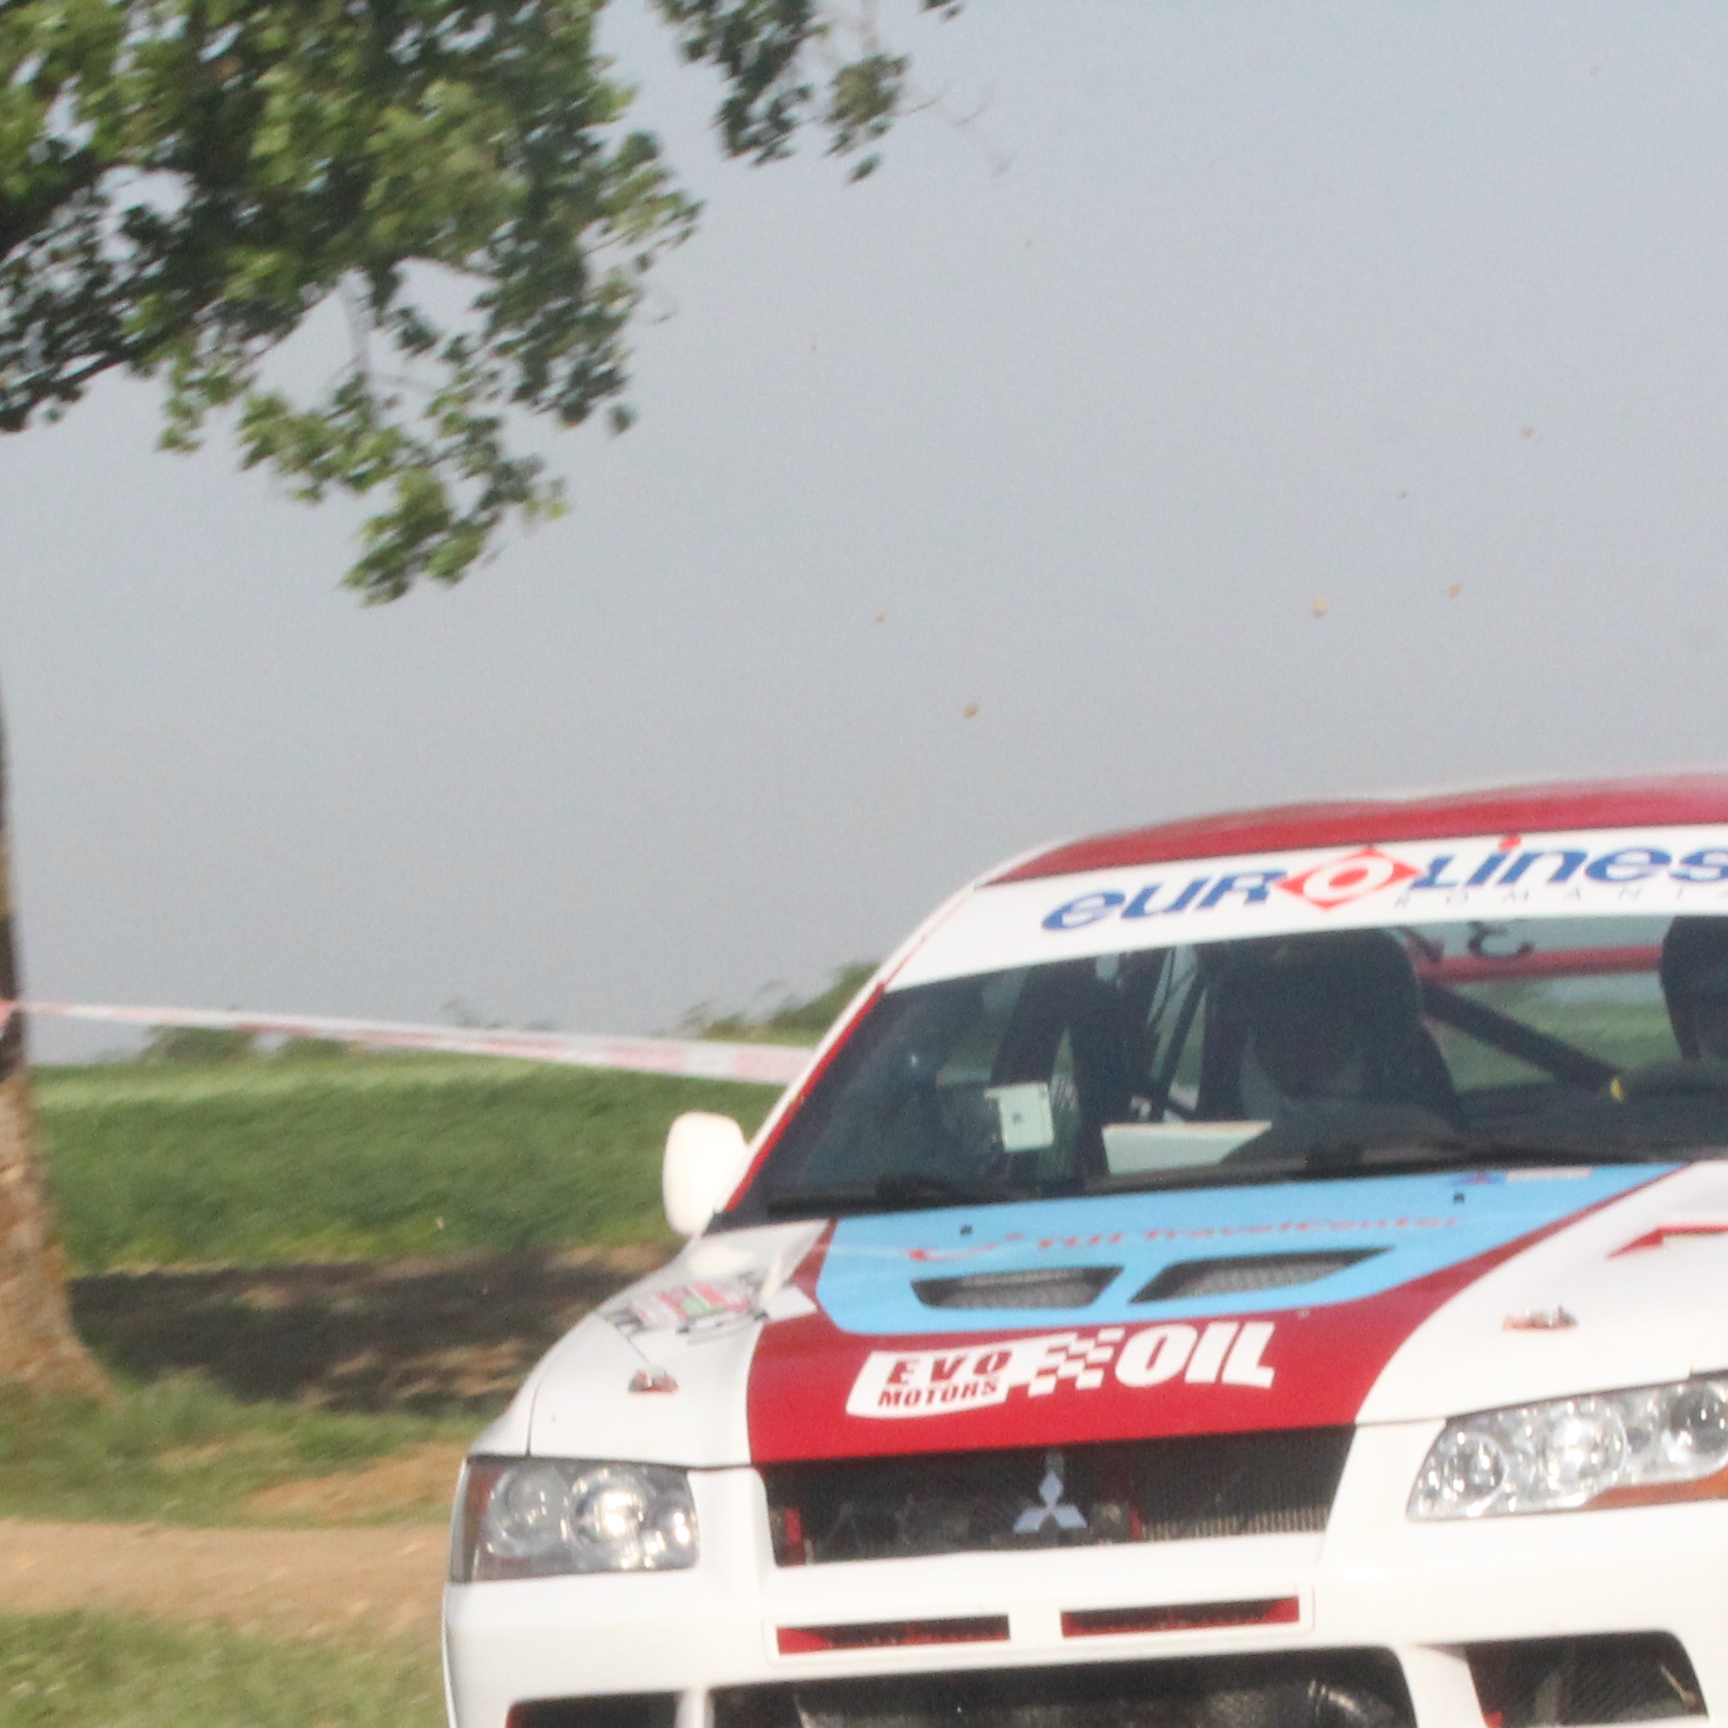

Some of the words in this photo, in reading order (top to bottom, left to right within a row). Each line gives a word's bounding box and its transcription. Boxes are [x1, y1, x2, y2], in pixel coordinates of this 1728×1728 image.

[885, 1346, 1014, 1386] EVO
[1114, 1321, 1276, 1389] OIL
[877, 1373, 1000, 1409] MOTORS
